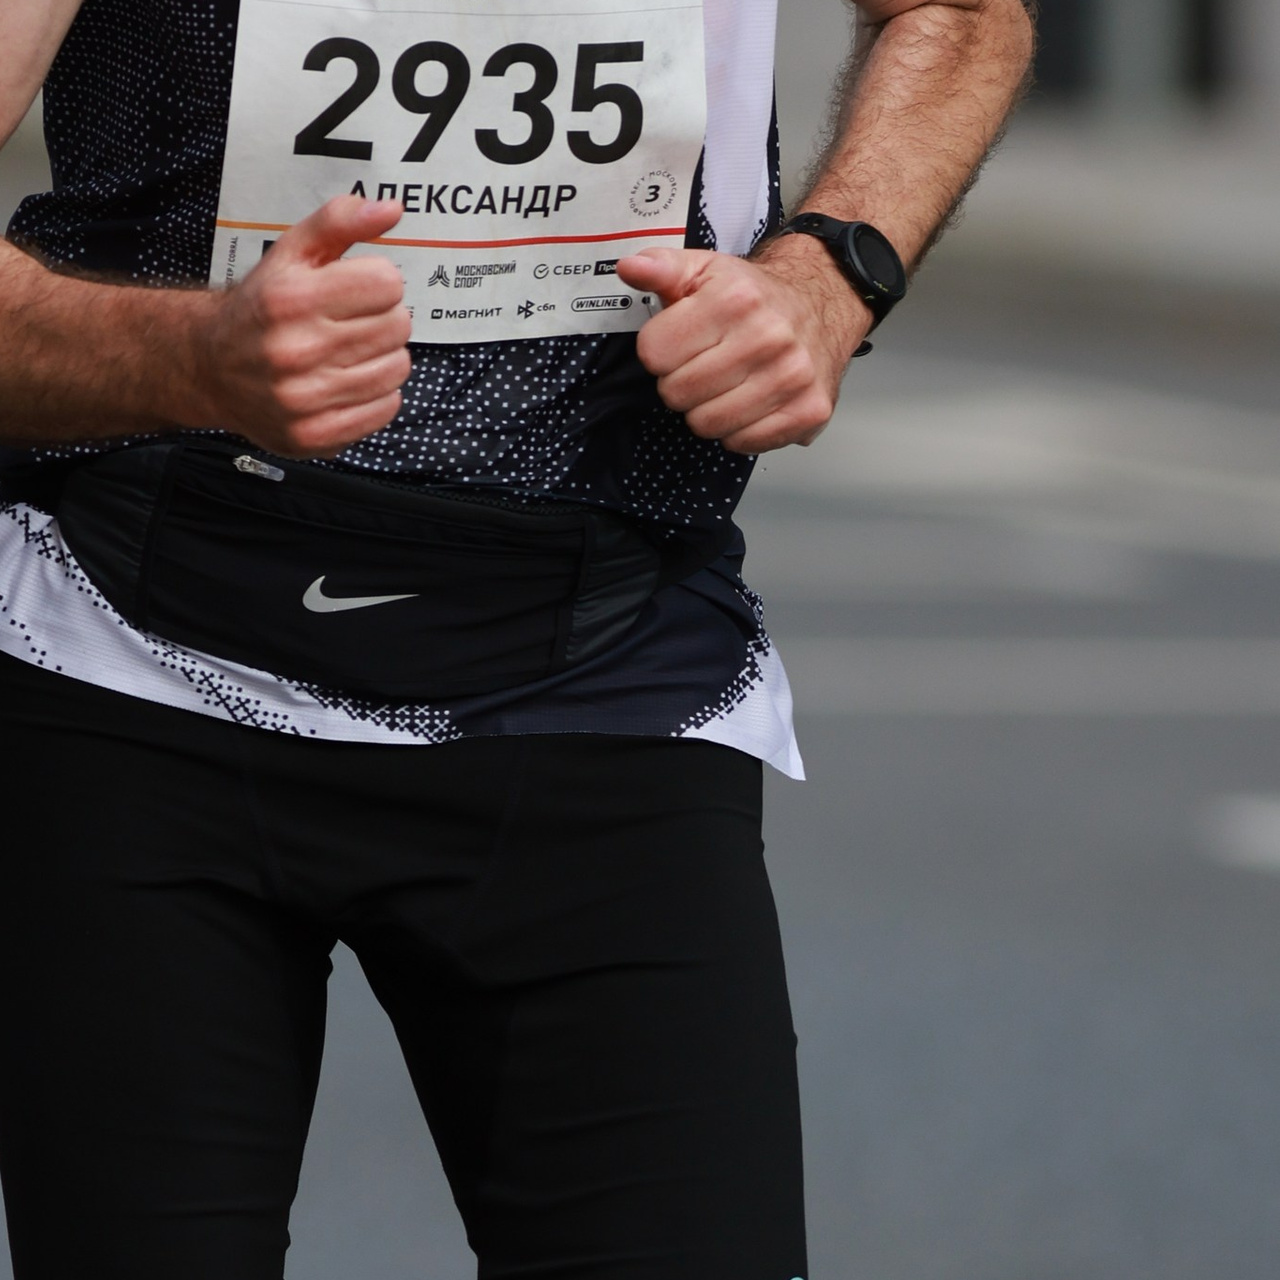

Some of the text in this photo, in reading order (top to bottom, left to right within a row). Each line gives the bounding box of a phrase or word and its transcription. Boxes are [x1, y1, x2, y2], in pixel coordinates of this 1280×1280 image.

[293, 36, 645, 166] 2935
[644, 184, 661, 203] 3
[228, 236, 239, 263] CORRAL
[455, 260, 516, 276] МОСКОВСКИЙ
[553, 263, 617, 276] СБЕР Пра
[454, 276, 484, 288] СПОРТ
[575, 298, 619, 309] WINLINE
